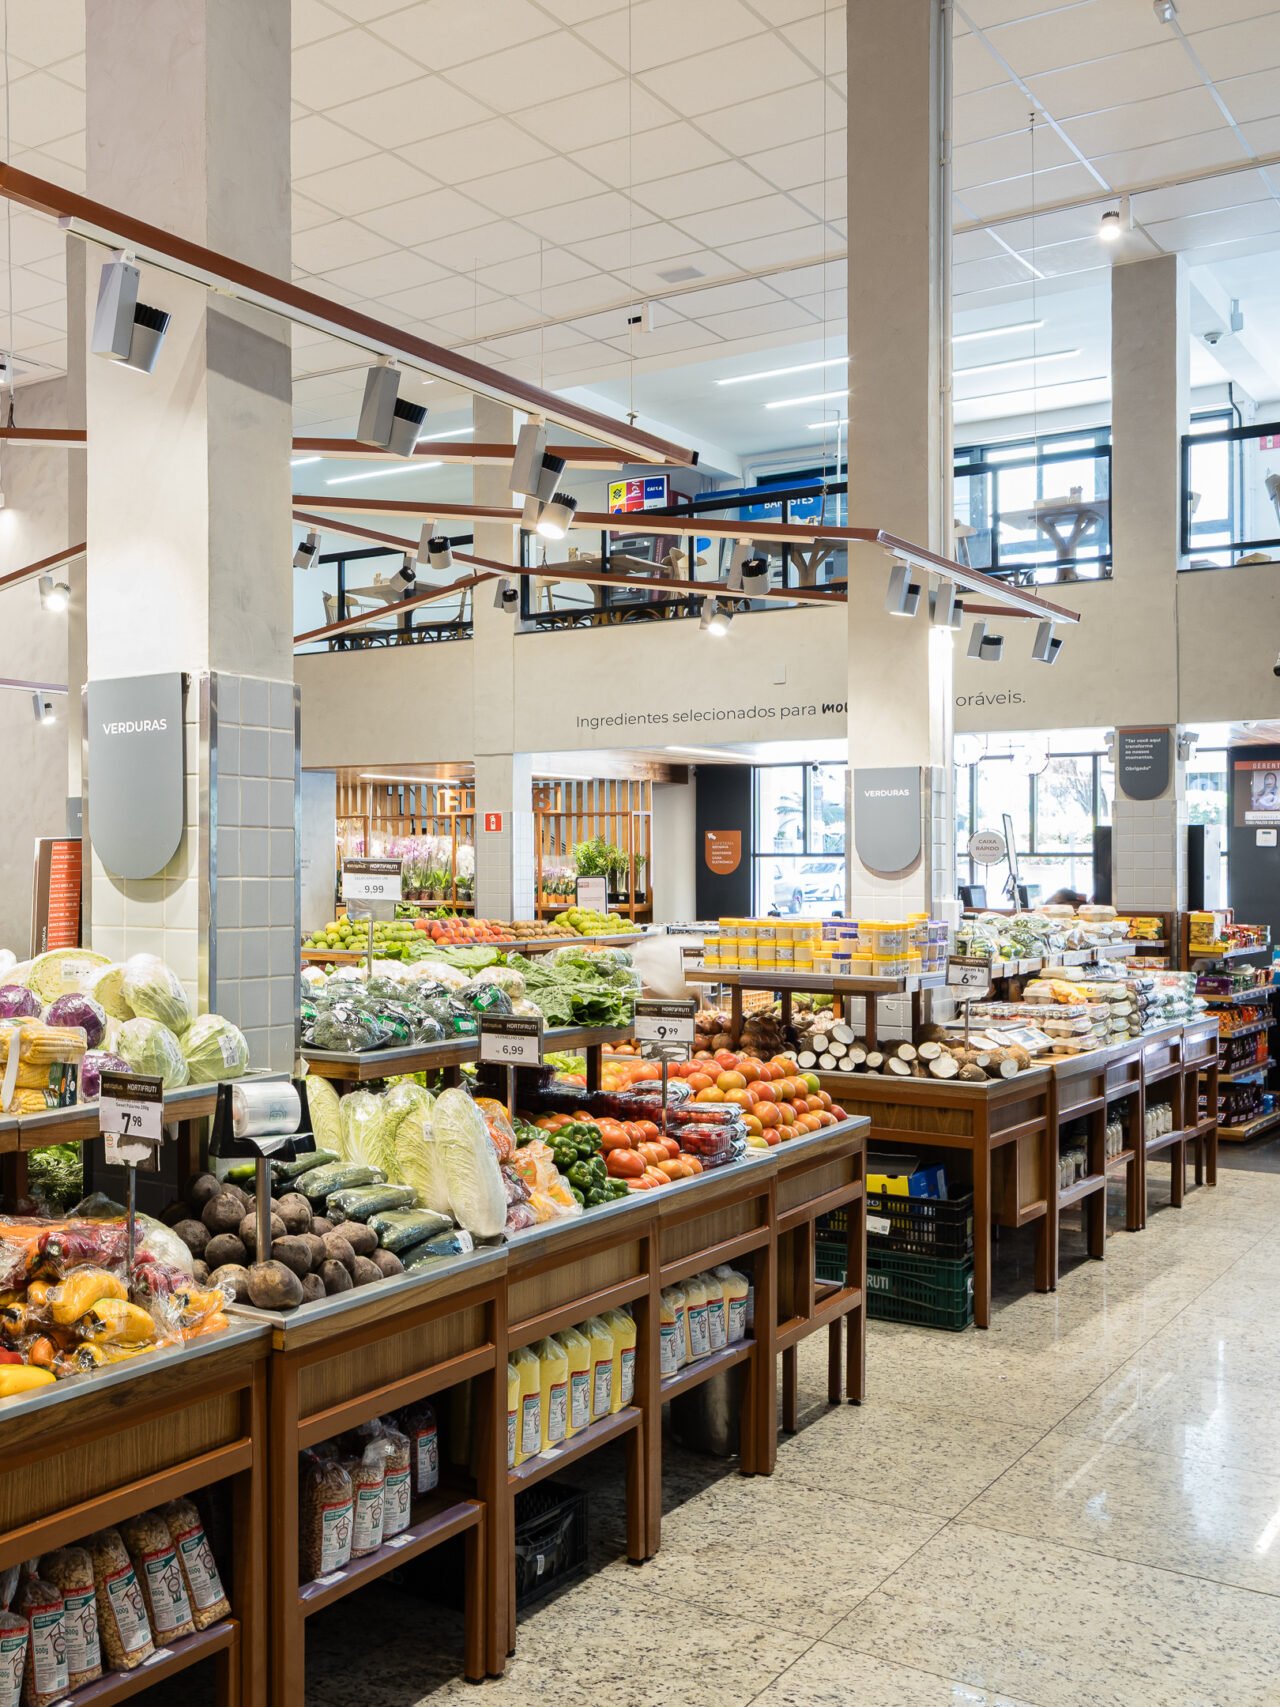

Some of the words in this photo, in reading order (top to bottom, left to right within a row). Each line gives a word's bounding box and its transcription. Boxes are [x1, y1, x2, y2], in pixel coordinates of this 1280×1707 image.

[576, 713, 669, 730] Ingredientes
[672, 705, 776, 724] selecionados
[780, 705, 816, 720] para
[103, 719, 167, 735] VERDURAS
[864, 789, 910, 797] VERDURAS
[127, 1083, 158, 1093] HORTIFRUTI
